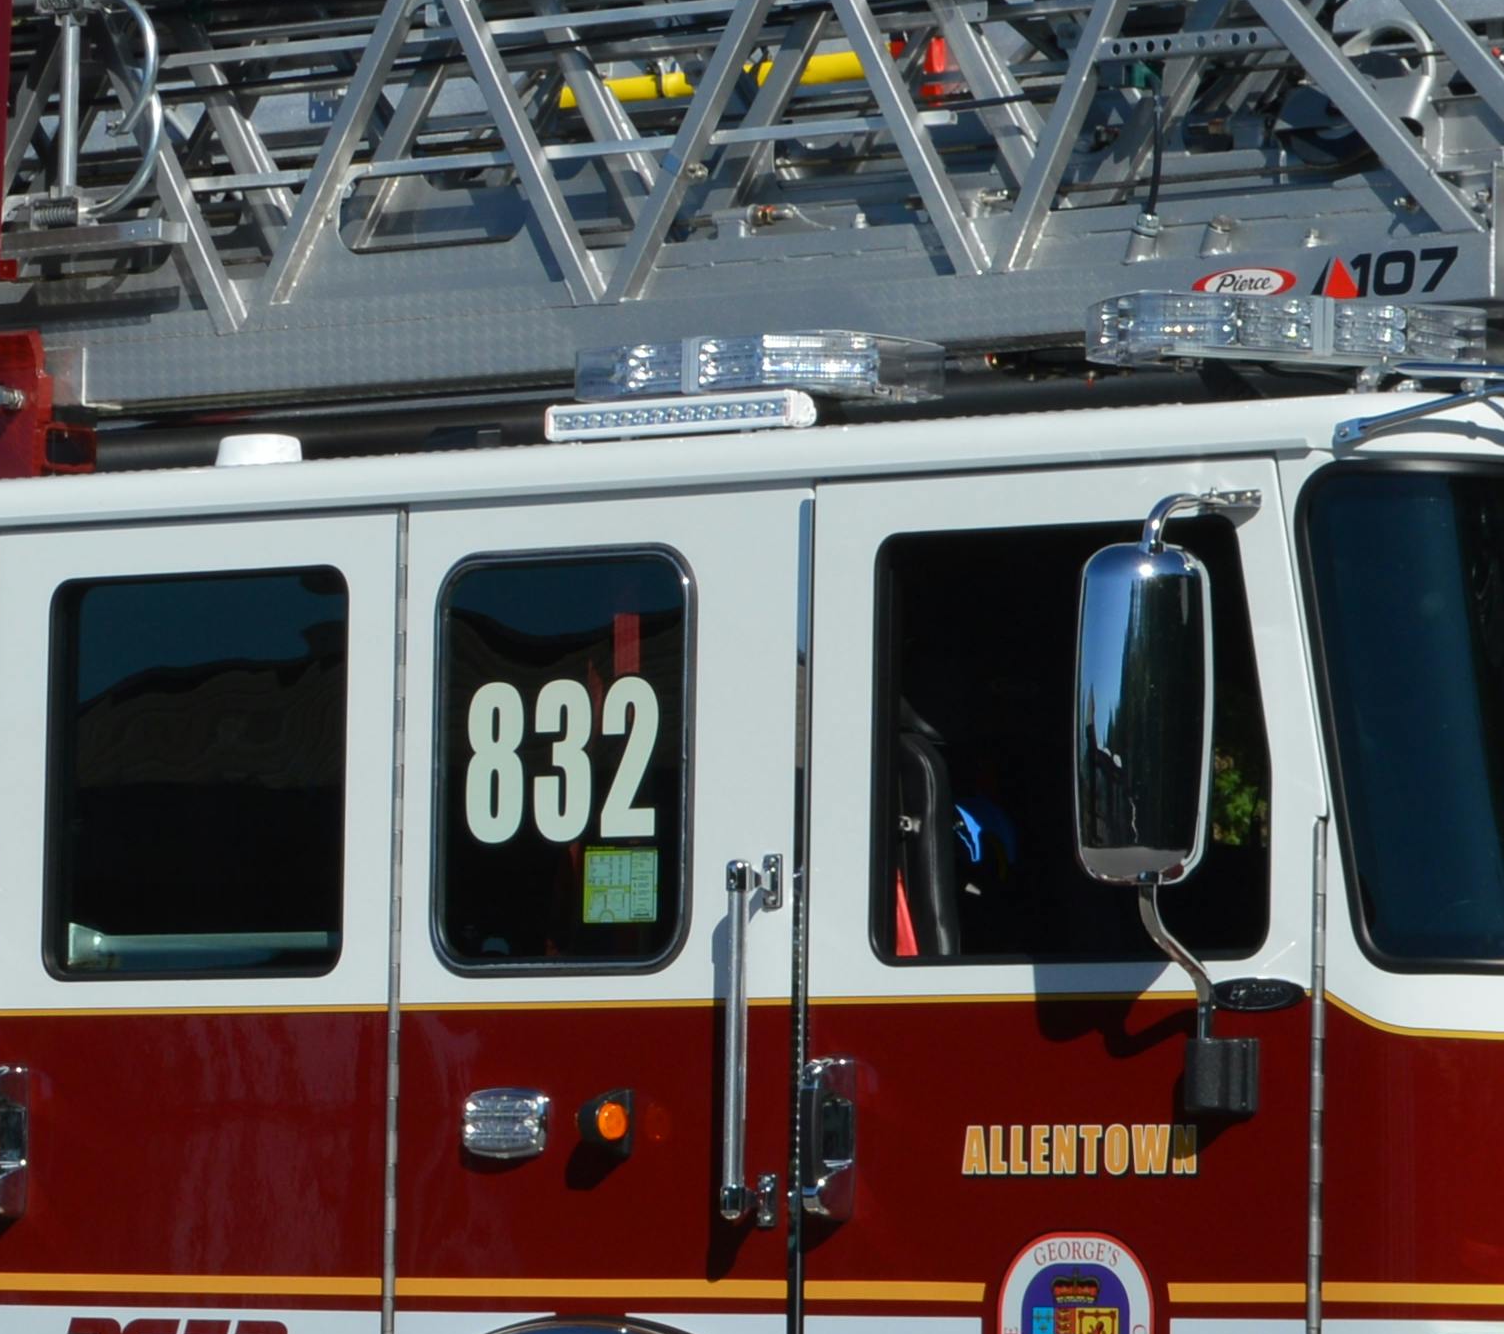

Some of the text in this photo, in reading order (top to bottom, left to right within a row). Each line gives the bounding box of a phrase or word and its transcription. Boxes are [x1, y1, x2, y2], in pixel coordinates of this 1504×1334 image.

[1214, 273, 1273, 294] Pierce
[465, 675, 660, 844] 832
[961, 1122, 1198, 1176] ALLENTOWN
[1033, 1240, 1121, 1267] GEORGE'S
